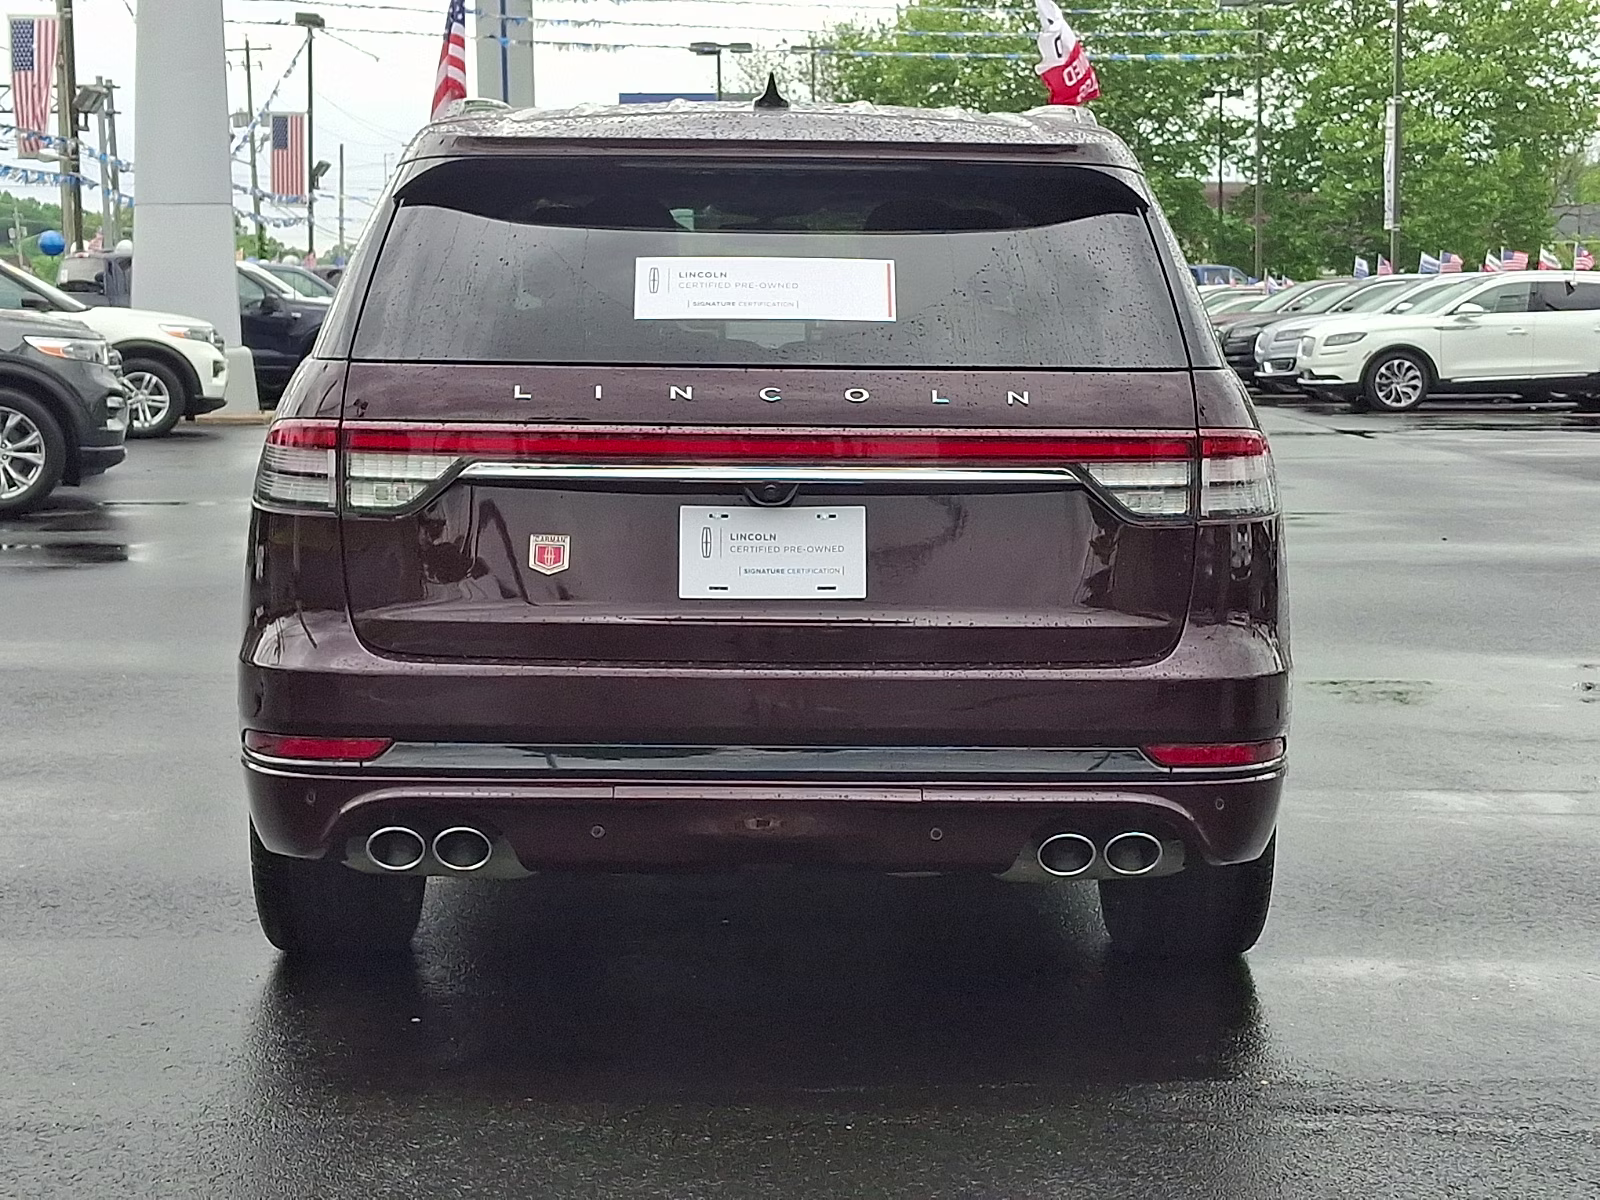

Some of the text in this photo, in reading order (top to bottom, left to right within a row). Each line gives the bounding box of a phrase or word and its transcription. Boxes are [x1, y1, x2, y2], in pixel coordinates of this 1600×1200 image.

[678, 271, 728, 279] LINCOLN
[678, 281, 732, 289] CERTIFIED
[513, 384, 1030, 405] LINCOLN
[729, 533, 777, 541] LINCOLN
[729, 545, 845, 553] CERTIFIED PRE-OWNED
